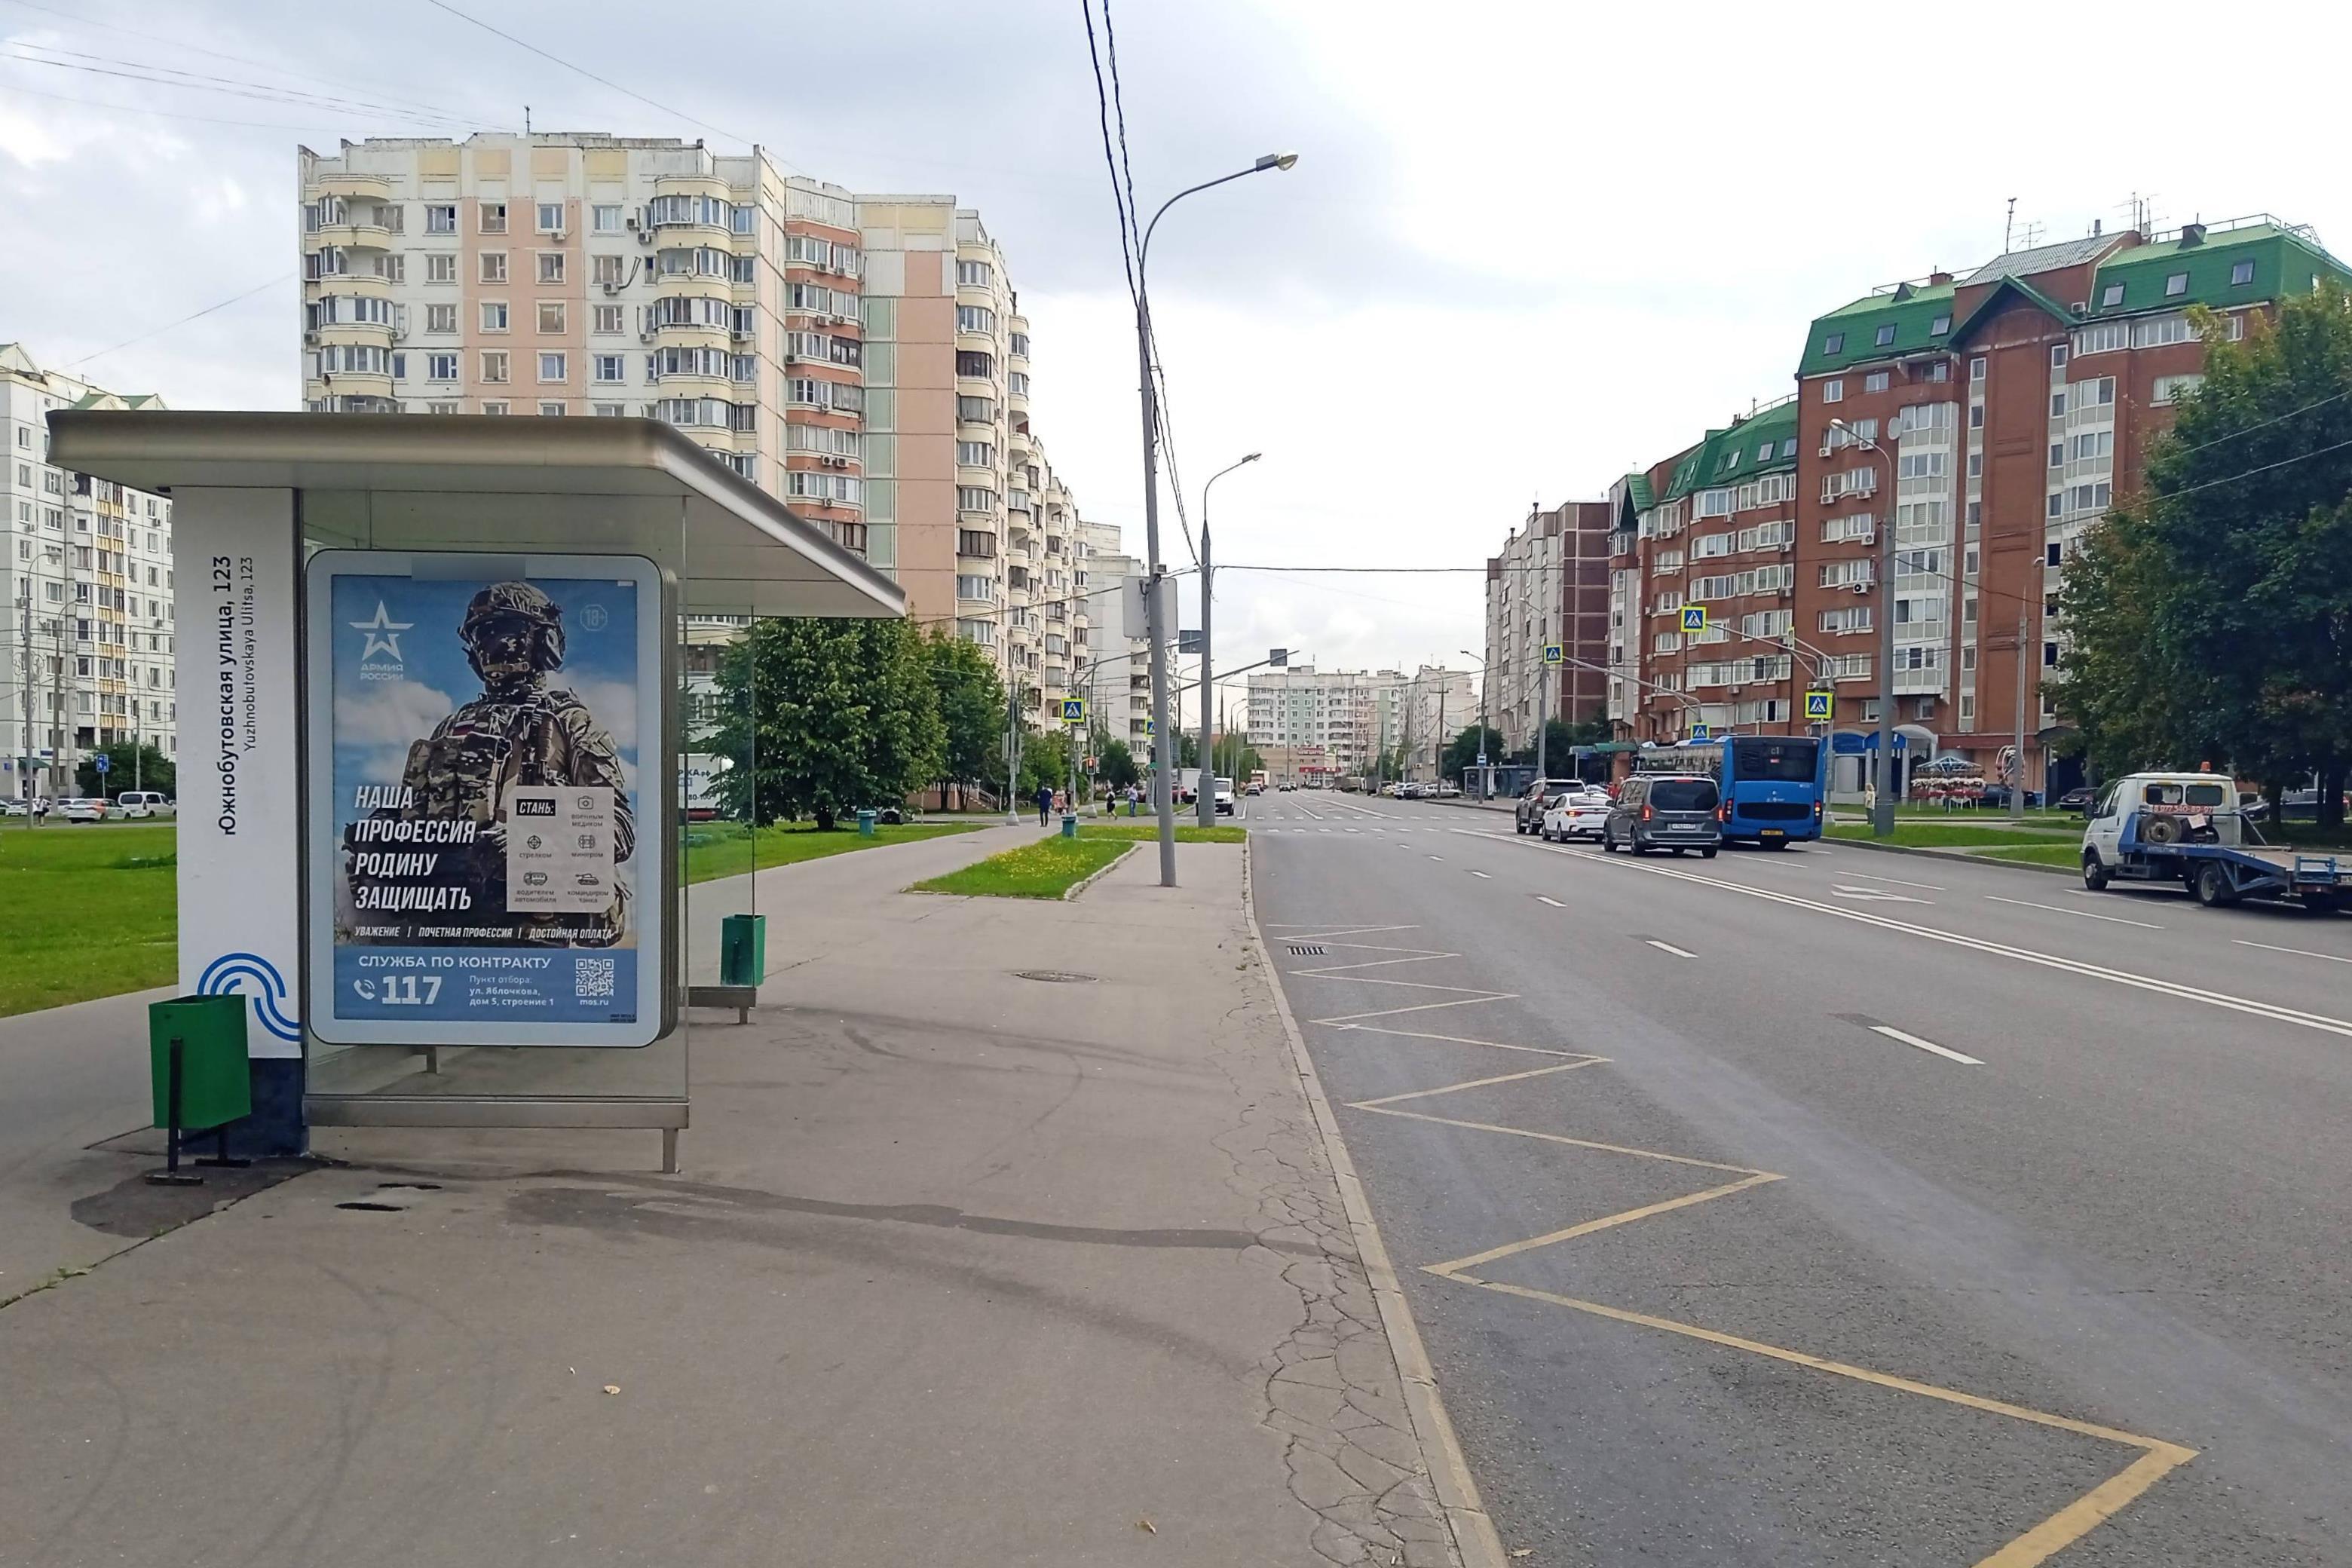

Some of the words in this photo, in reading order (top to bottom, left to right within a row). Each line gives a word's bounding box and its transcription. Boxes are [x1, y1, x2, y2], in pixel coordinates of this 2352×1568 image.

[213, 556, 231, 593] 123
[240, 556, 253, 581] 123
[240, 584, 255, 626] Ulitsa,
[218, 601, 237, 666] улица,
[360, 663, 403, 672] АРМИЯ
[360, 672, 403, 681] РОССИИ
[242, 629, 257, 752] Yuzhnobutovskaya
[216, 670, 239, 835] Южнобутовская
[354, 786, 414, 809] НАША
[519, 801, 554, 815] СТАНЬ:
[354, 819, 476, 844] ПРОФЕССИЯ
[354, 853, 438, 878] РОДИНУ
[355, 886, 472, 912] ЗАЩИЩАТЬ
[354, 926, 400, 938] УВАЖЕНИЕ
[418, 926, 461, 938] ПОЧЕТНАЯ
[462, 927, 513, 939] ПРОФЕССИЯ
[528, 926, 579, 940] ДОСТОЙНАЯ
[579, 928, 612, 939] ОПЛАТА
[358, 956, 427, 967] СЛУЖБА
[431, 957, 454, 968] ПО
[458, 957, 551, 969] КОНТРАКТУ
[381, 975, 443, 1005] 117
[469, 975, 496, 985] Пункт
[498, 975, 532, 985] отбора:
[469, 988, 484, 997] ул.
[485, 987, 541, 996] Яблочкова,
[469, 998, 489, 1007] дом
[491, 997, 500, 1006] 5,
[501, 998, 547, 1007] строение
